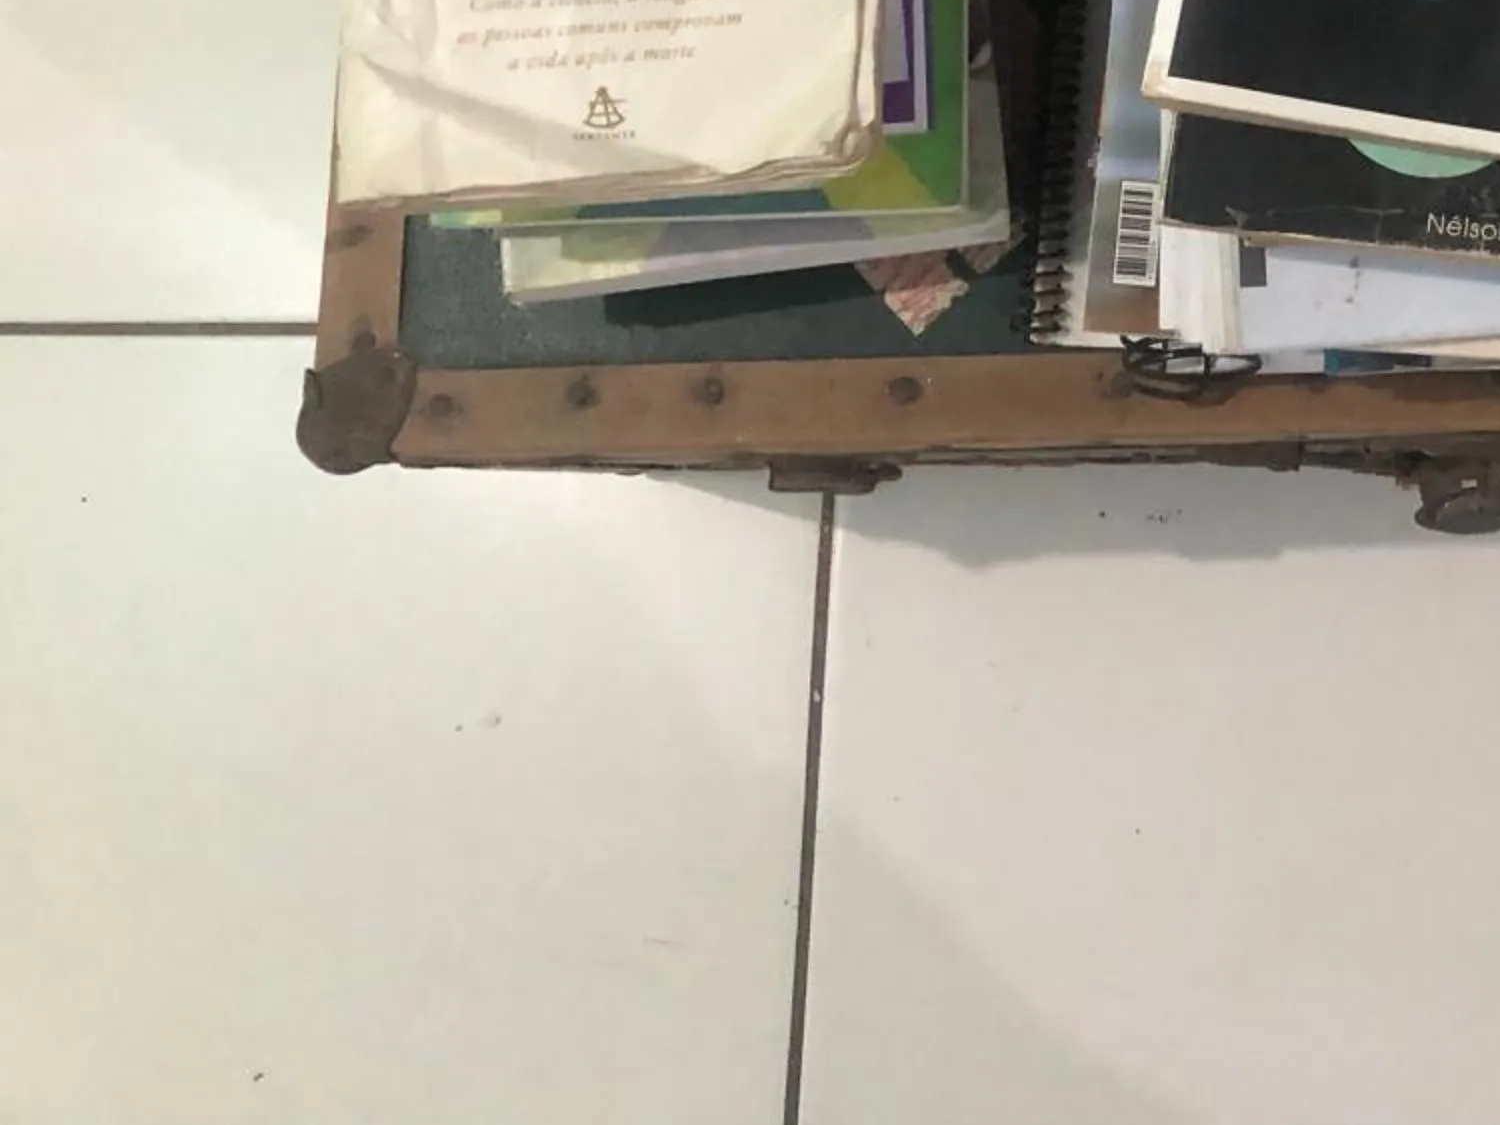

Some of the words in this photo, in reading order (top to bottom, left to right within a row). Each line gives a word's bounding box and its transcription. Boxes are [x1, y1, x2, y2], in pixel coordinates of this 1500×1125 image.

[634, 12, 743, 36] comprovam
[526, 49, 569, 70] vida
[643, 44, 697, 61] morte
